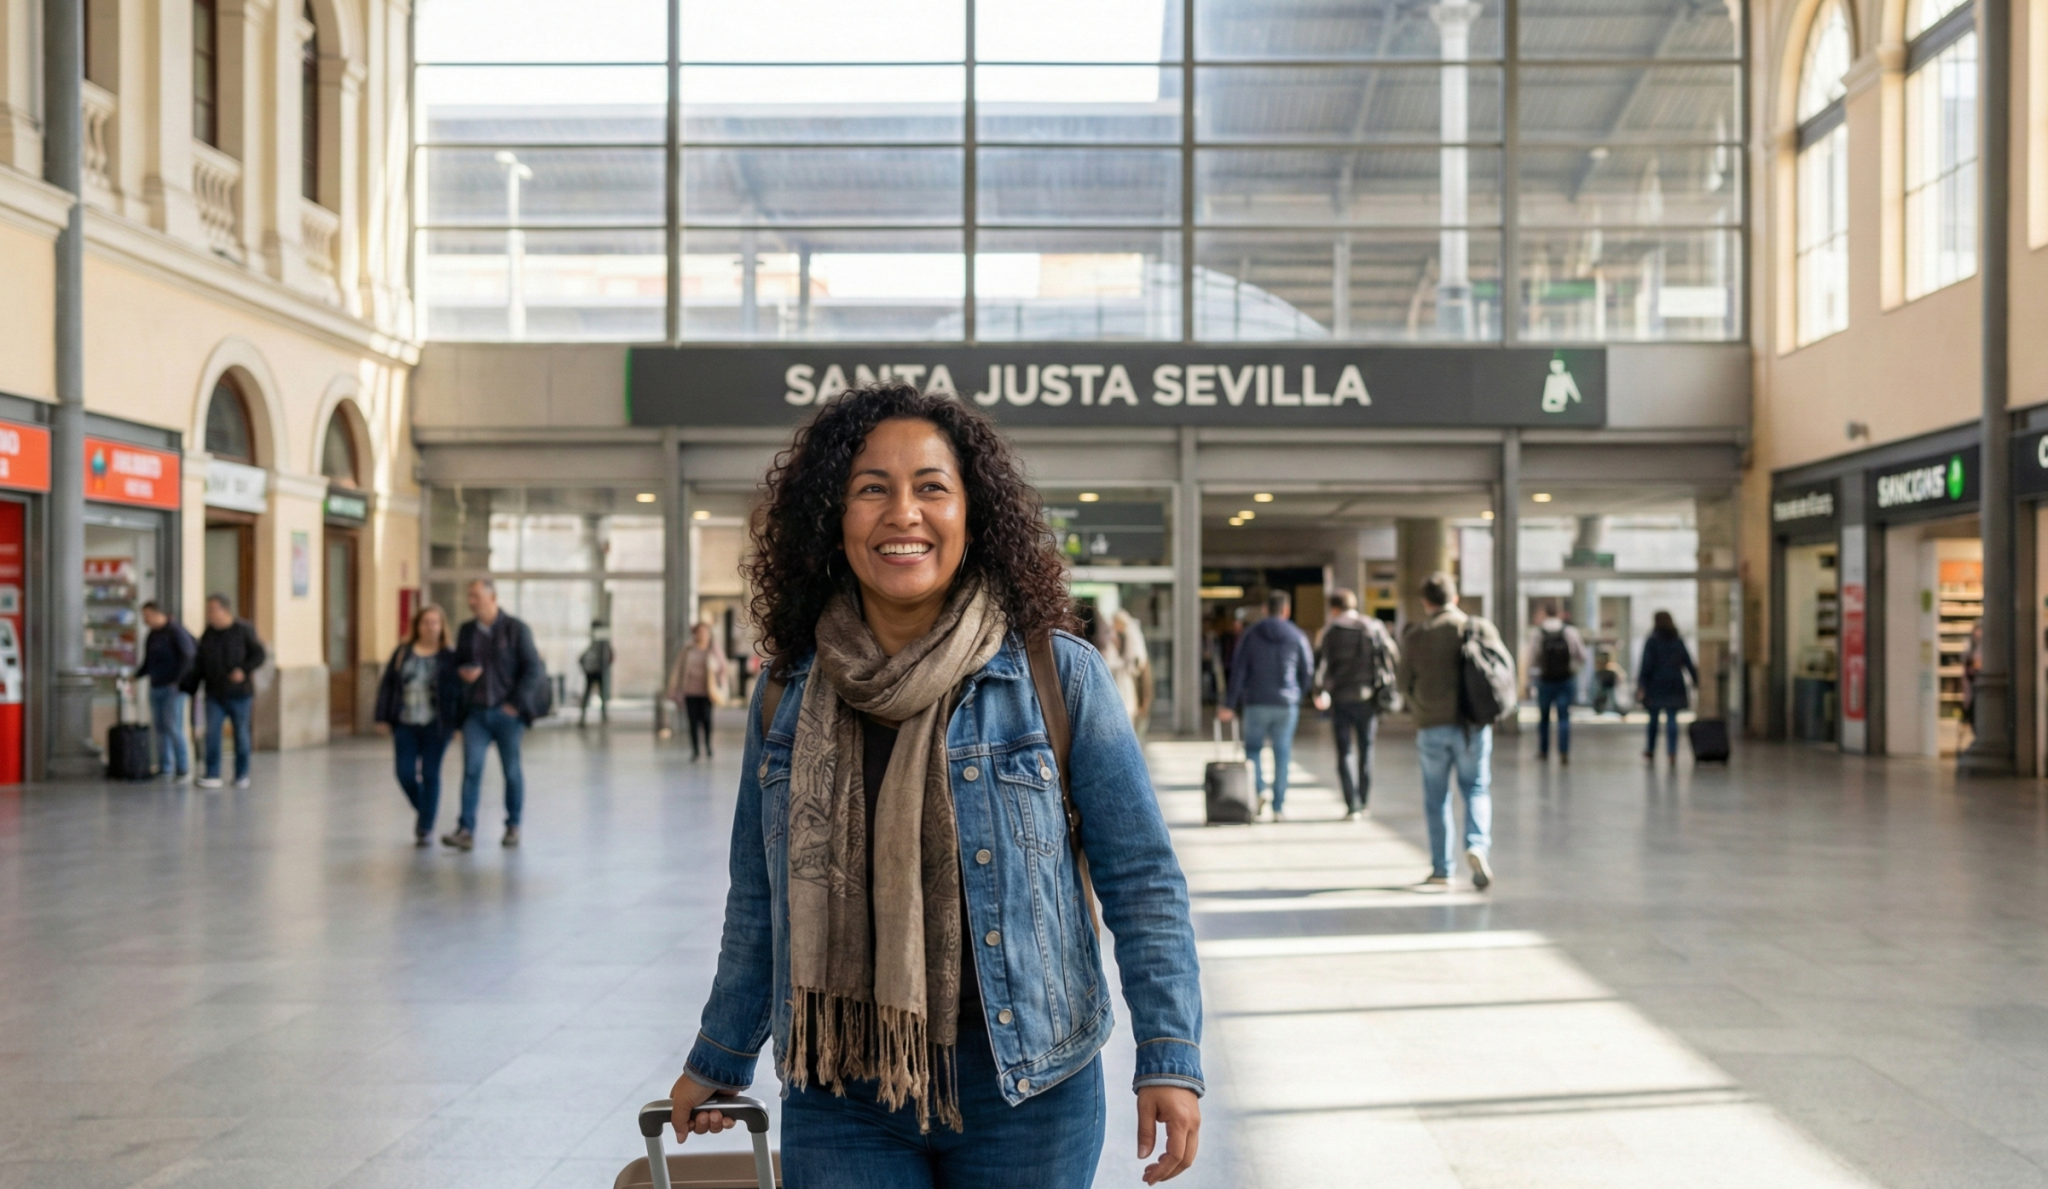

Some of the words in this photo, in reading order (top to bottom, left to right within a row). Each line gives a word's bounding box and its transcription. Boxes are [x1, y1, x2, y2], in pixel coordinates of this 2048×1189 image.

[784, 363, 961, 406] SANTA
[974, 364, 1138, 406] JUSTA
[1152, 364, 1372, 406] SEVILLA
